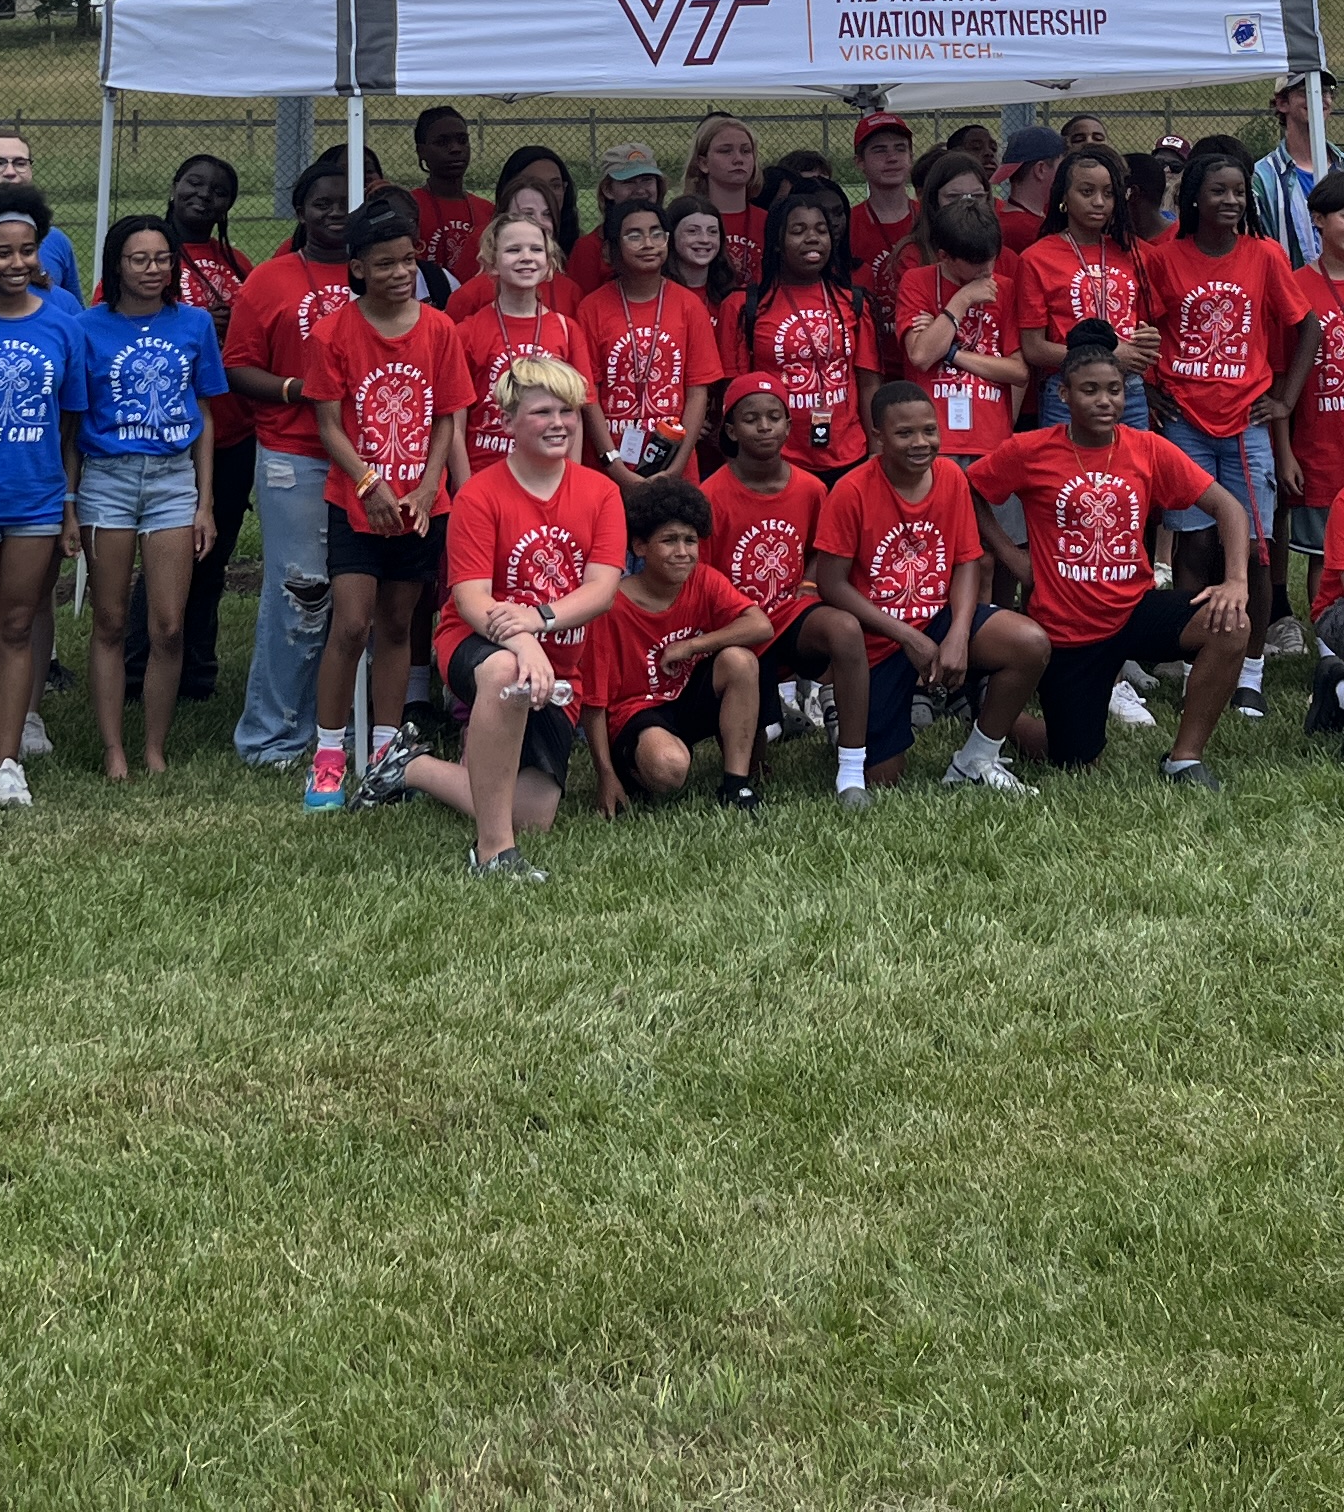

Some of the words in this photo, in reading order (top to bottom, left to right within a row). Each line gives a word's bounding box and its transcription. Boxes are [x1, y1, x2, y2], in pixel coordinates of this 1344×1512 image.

[838, 10, 945, 39] AVIATION
[952, 8, 1108, 37] PARTNERSHIP
[839, 43, 935, 61] VIRGINIA
[941, 42, 992, 59] TECH
[427, 226, 449, 261] RGINIA
[726, 234, 756, 248] TECH
[179, 268, 194, 306] VIRGINI
[297, 291, 324, 340] VIRGINI
[325, 285, 351, 294] TEC
[1180, 286, 1206, 333] VIRGINIA
[1207, 281, 1241, 295] TECH
[1241, 300, 1251, 333] WING
[774, 314, 799, 364] VIRGINIA
[636, 327, 670, 343] TEH
[671, 349, 682, 385] WING
[1188, 346, 1201, 354] 20
[2, 340, 39, 355] TECH
[41, 359, 54, 395] WING
[110, 345, 136, 402] VIRGINIA
[136, 337, 173, 351] TECH
[178, 354, 190, 391] WING
[1172, 360, 1209, 377] DRONE
[1214, 364, 1246, 378] CAMP
[792, 375, 805, 383] 20
[1326, 378, 1339, 386] 20
[386, 363, 422, 380] TECH
[423, 386, 433, 426] WING
[617, 400, 629, 408] 20
[656, 398, 669, 407] 25
[788, 393, 821, 409] RONE
[977, 384, 1001, 403] CAMP
[127, 412, 141, 422] 20
[8, 427, 44, 442] CAMP
[1056, 475, 1085, 528] VIRGINIA
[1086, 472, 1124, 487] TECH
[1128, 491, 1139, 530] WING
[507, 529, 540, 588] VIRGINIA
[540, 525, 570, 543] TCH
[731, 525, 760, 585] VIRGINIA
[761, 519, 796, 536] TECH
[1069, 545, 1083, 554] 20
[1102, 565, 1137, 581] CAMP
[881, 589, 895, 598] 20
[661, 627, 692, 644] TECH
